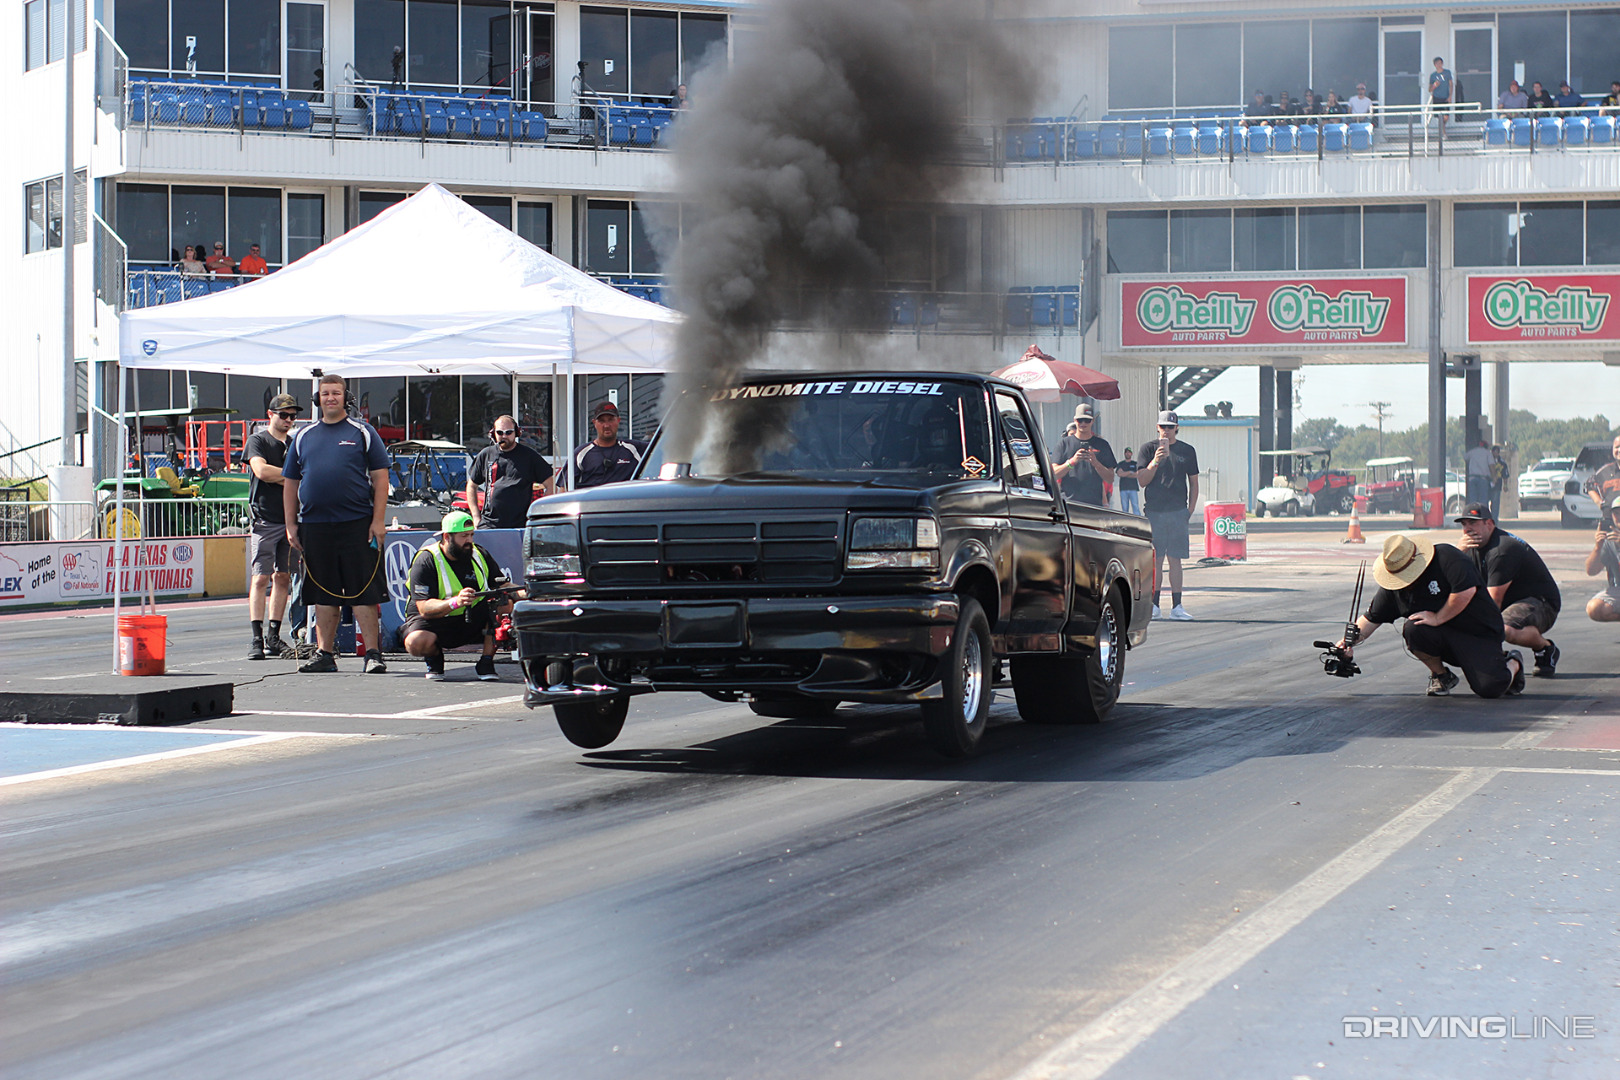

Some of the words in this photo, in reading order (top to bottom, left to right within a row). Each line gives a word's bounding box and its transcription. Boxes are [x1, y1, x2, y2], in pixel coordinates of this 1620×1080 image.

[1143, 292, 1249, 329] O'Reilly
[1274, 291, 1381, 328] O'Reilly
[1490, 286, 1601, 325] O'Reilly
[1172, 332, 1196, 342] AUTO
[1197, 331, 1226, 341] PARTS
[1304, 331, 1328, 341] AUTO
[1329, 330, 1358, 340] PARTS
[1521, 328, 1546, 337] AUTO
[1547, 327, 1578, 337] PARTS
[710, 381, 846, 402] DYNOMITE
[851, 381, 944, 396] DIESEL
[106, 545, 130, 568] AA
[174, 545, 192, 562] NHRA
[28, 555, 52, 574] Home
[31, 574, 41, 589] of
[42, 570, 56, 584] the
